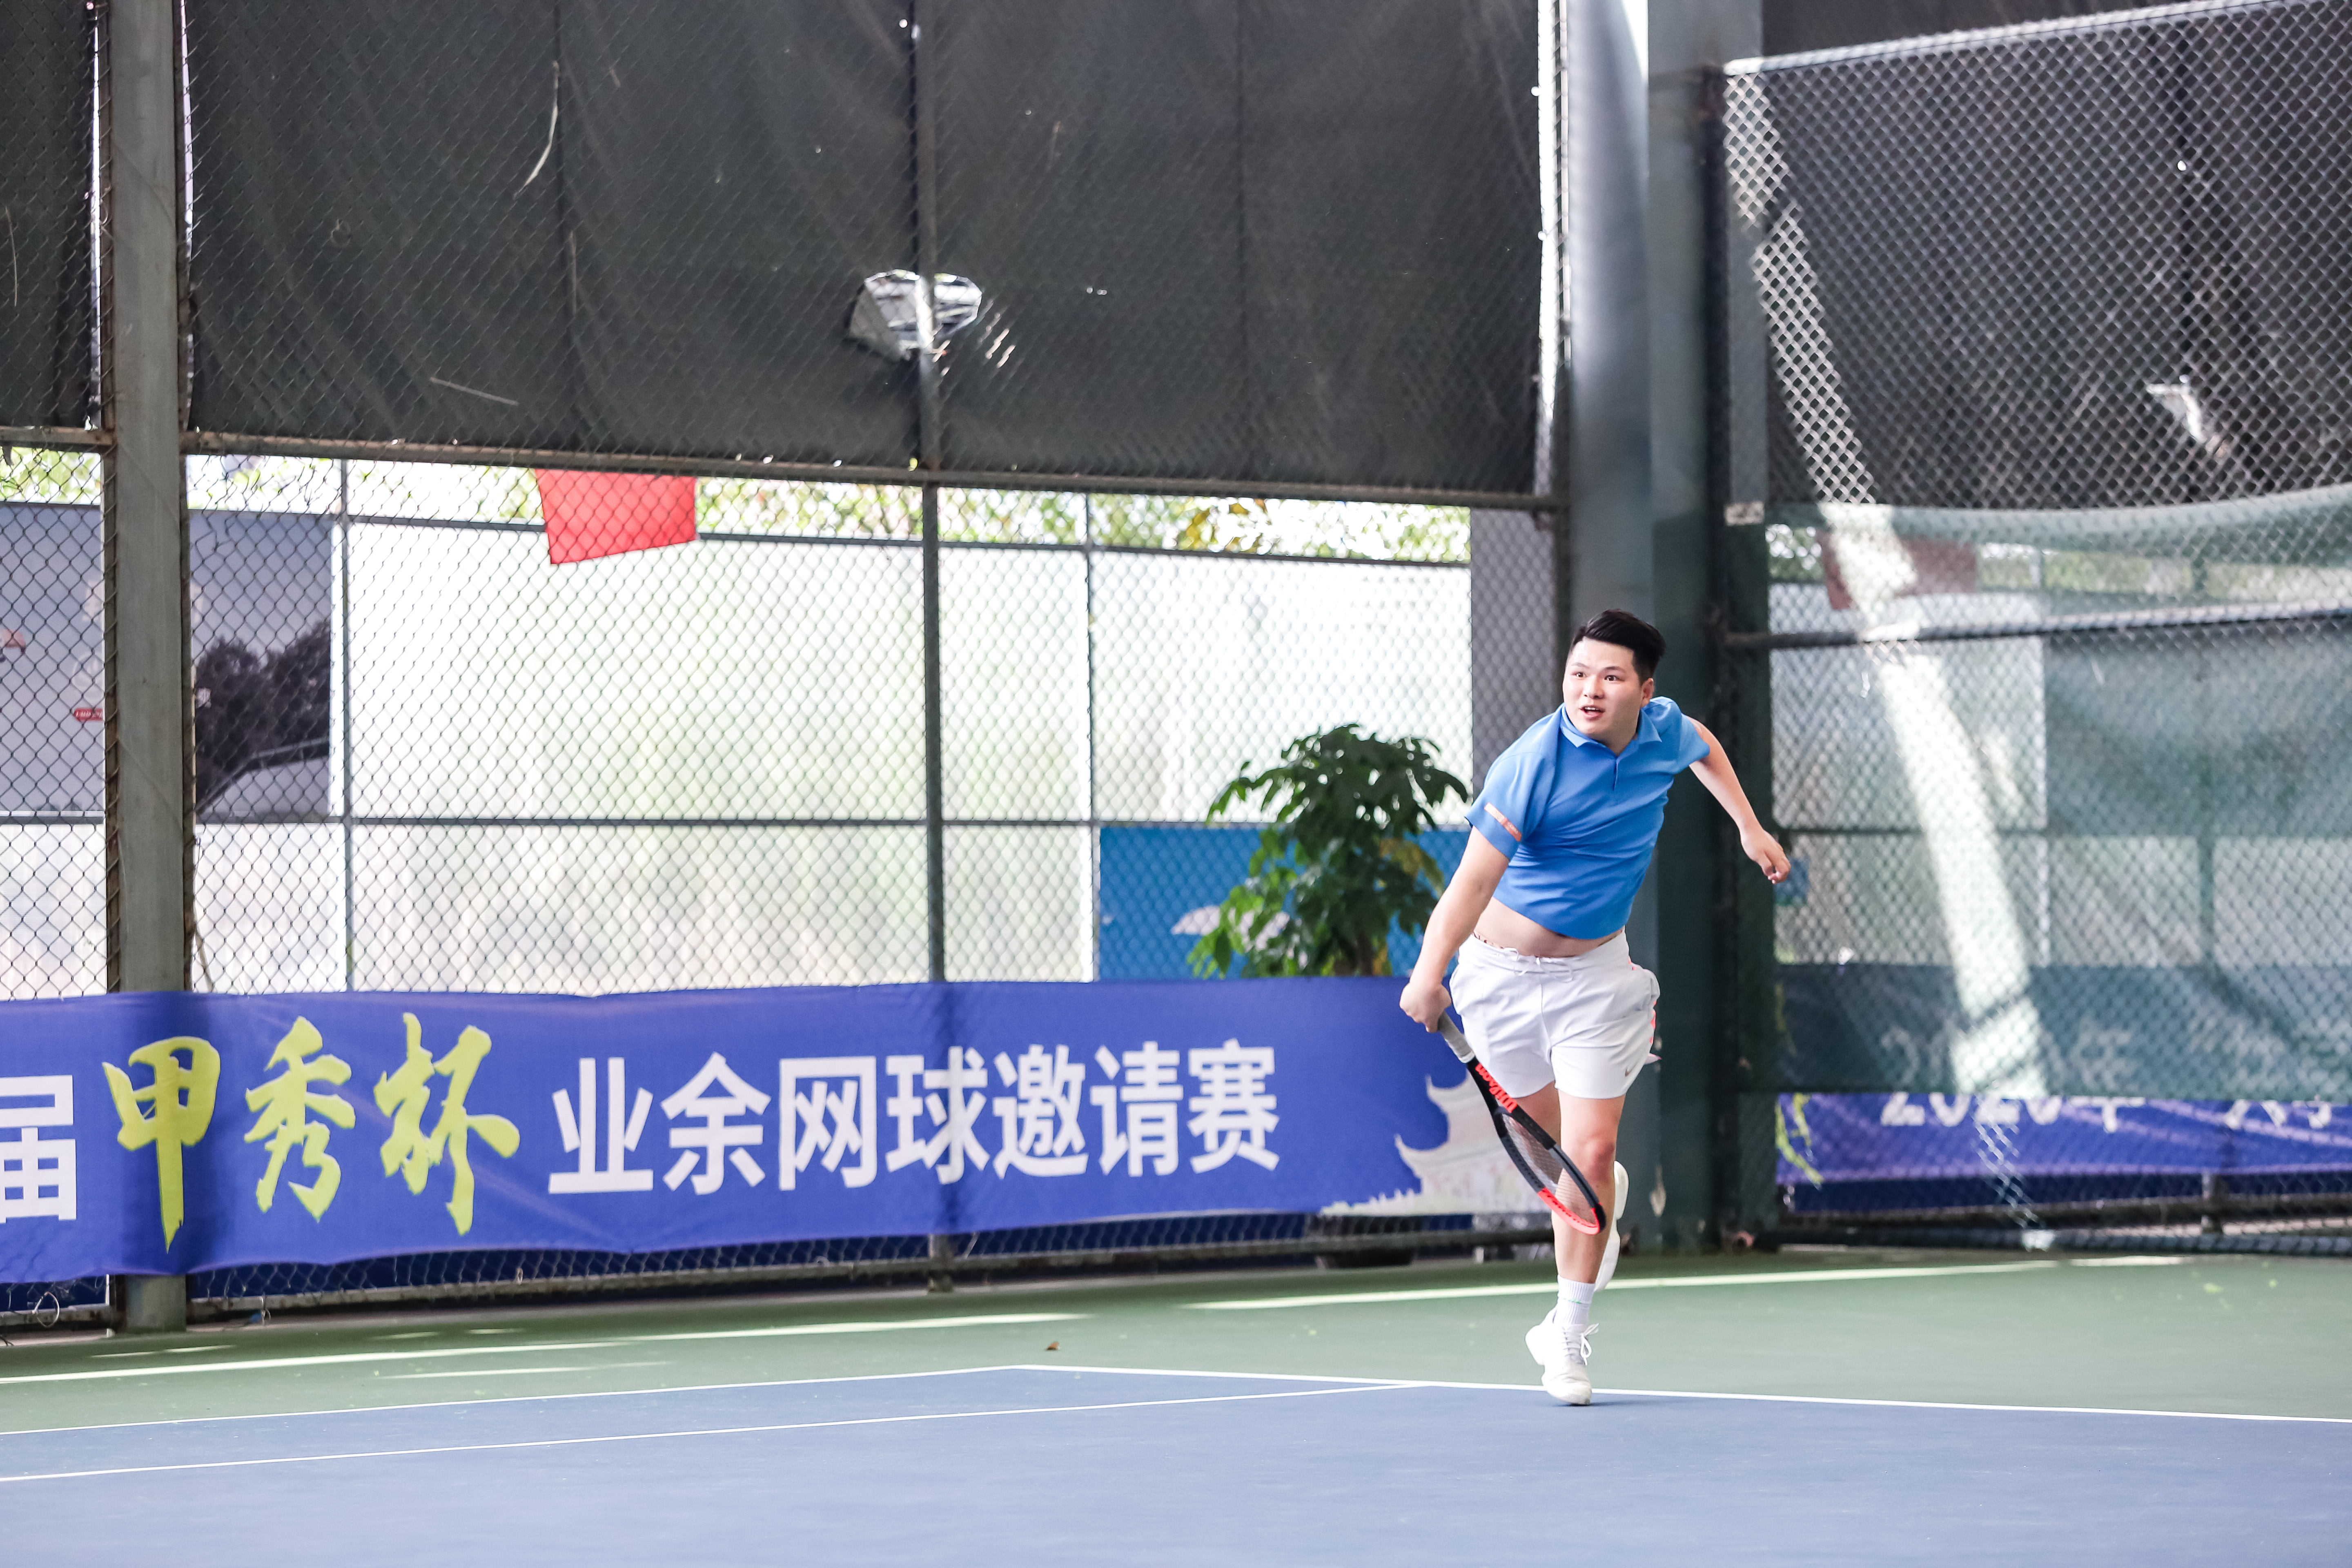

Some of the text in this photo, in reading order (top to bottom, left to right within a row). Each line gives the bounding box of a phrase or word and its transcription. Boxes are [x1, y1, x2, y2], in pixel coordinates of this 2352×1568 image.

[0, 1013, 1279, 1252] 届 甲秀杯 业余网球邀请赛
[1475, 1062, 1519, 1113] Wilson
